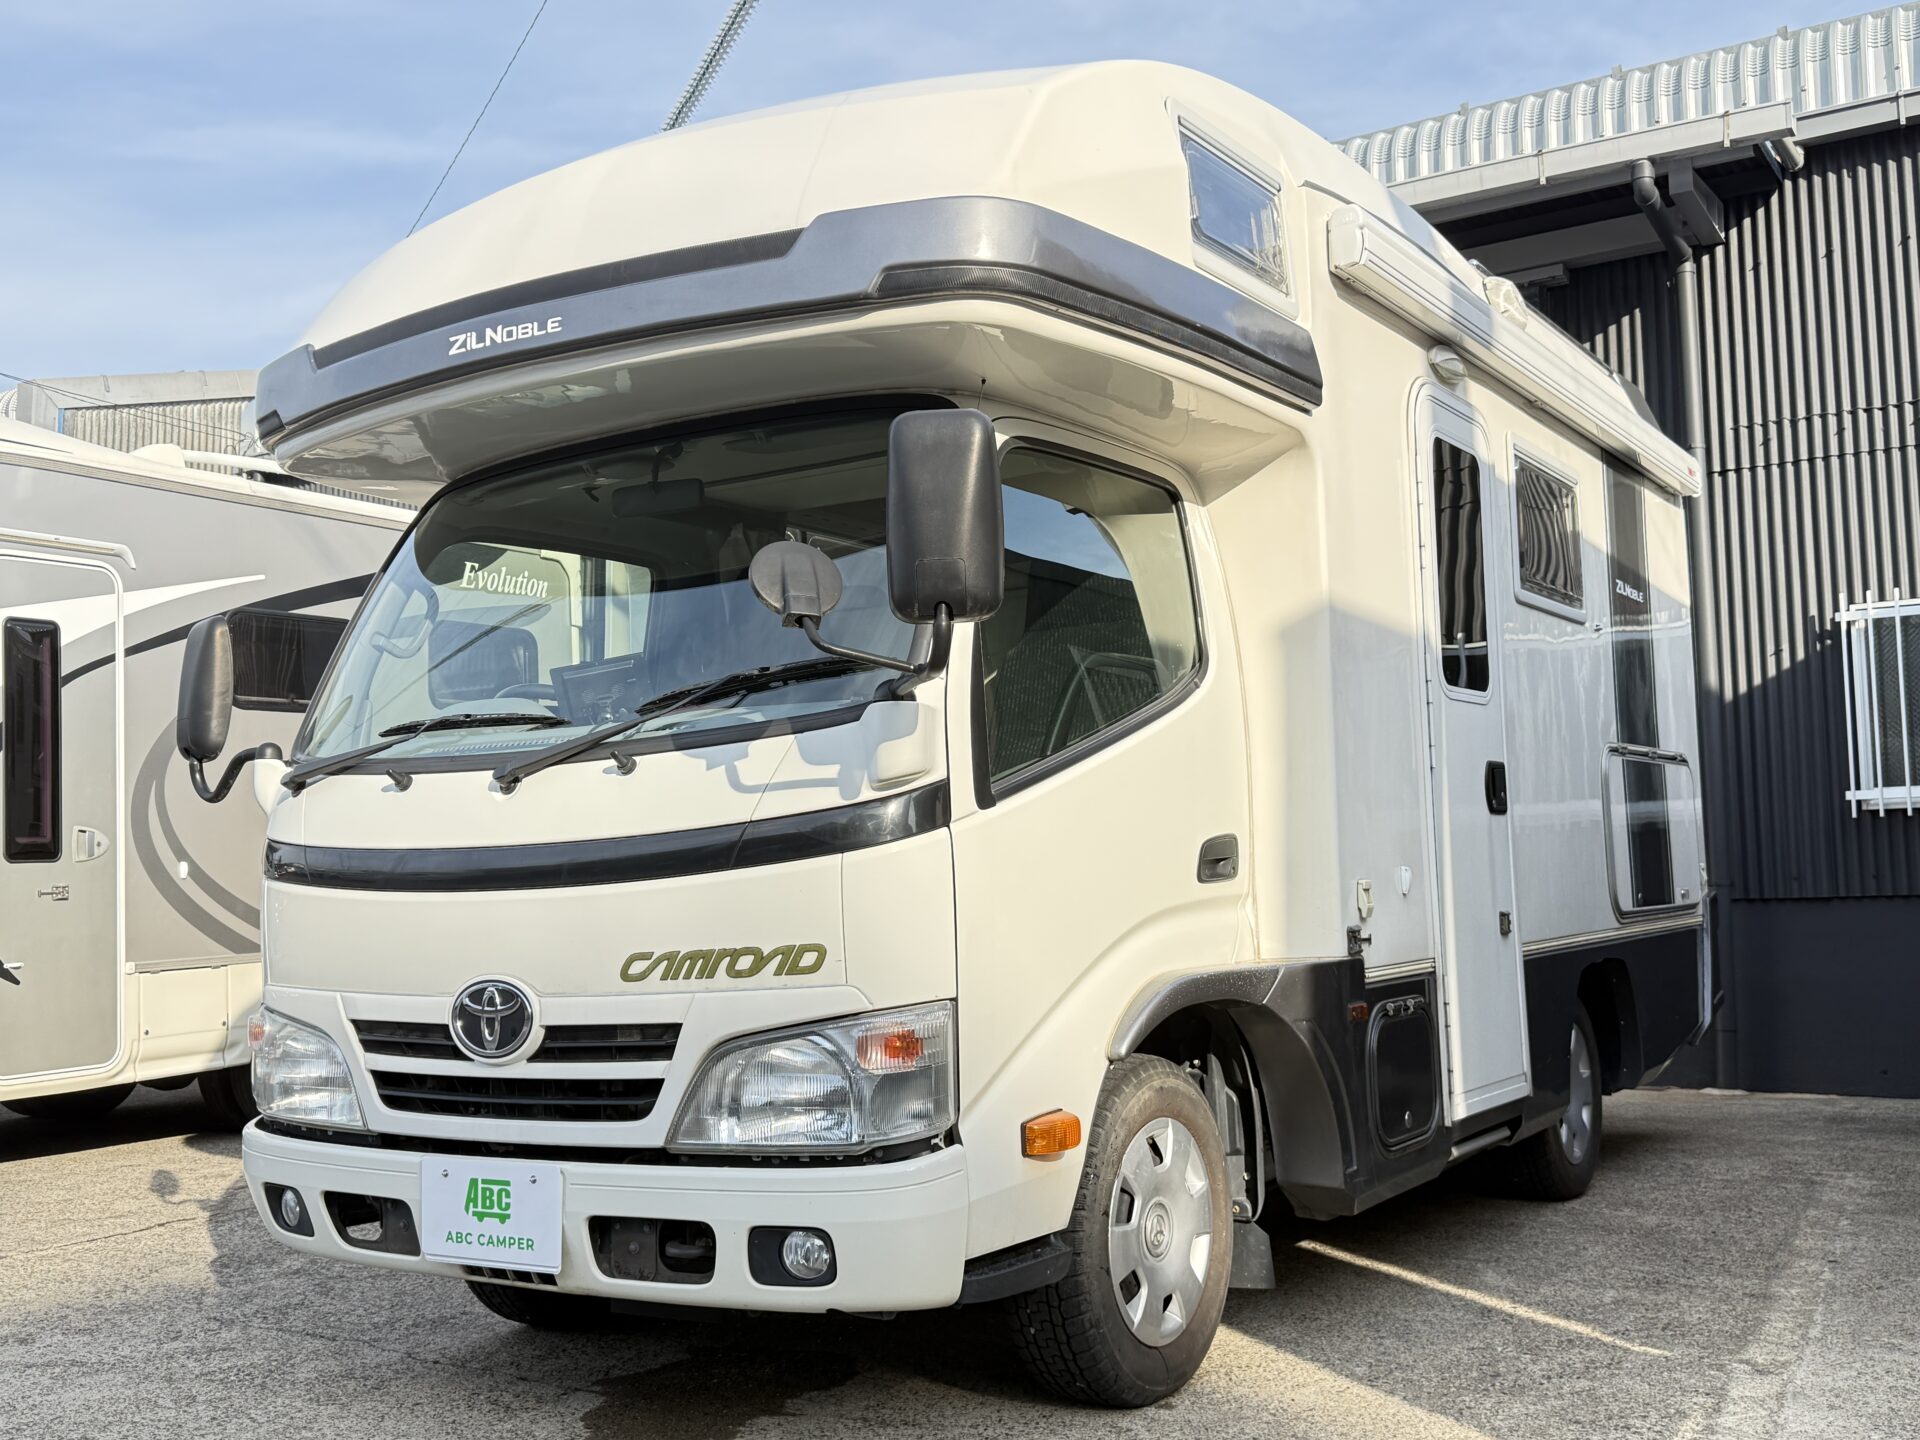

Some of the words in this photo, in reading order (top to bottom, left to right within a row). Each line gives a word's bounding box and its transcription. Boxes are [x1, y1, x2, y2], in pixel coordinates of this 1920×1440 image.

[460, 561, 548, 598] Evolution
[620, 943, 827, 983] CAMROAD
[464, 1177, 512, 1216] ABC
[445, 1230, 473, 1245] ABC
[477, 1233, 535, 1251] CAMPER
